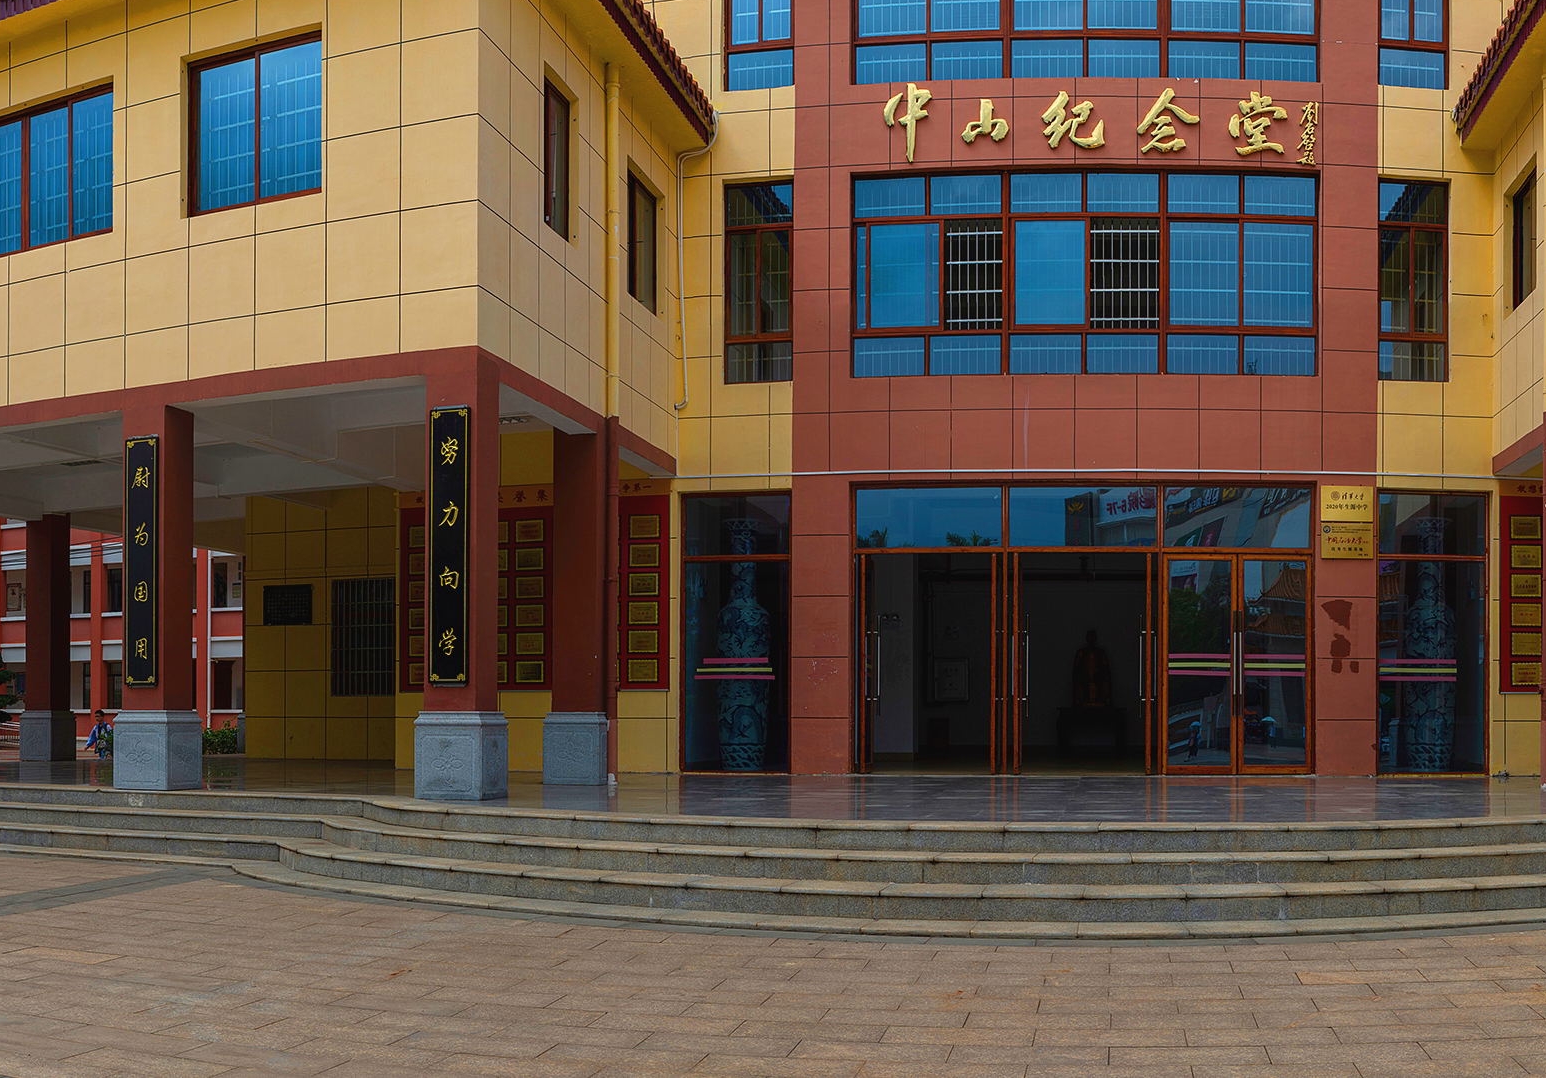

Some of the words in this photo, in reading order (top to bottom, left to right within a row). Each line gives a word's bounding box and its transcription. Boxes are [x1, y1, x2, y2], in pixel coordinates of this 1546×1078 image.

[883, 82, 1289, 163] 中山纪念堂
[438, 436, 460, 657] 努力向学
